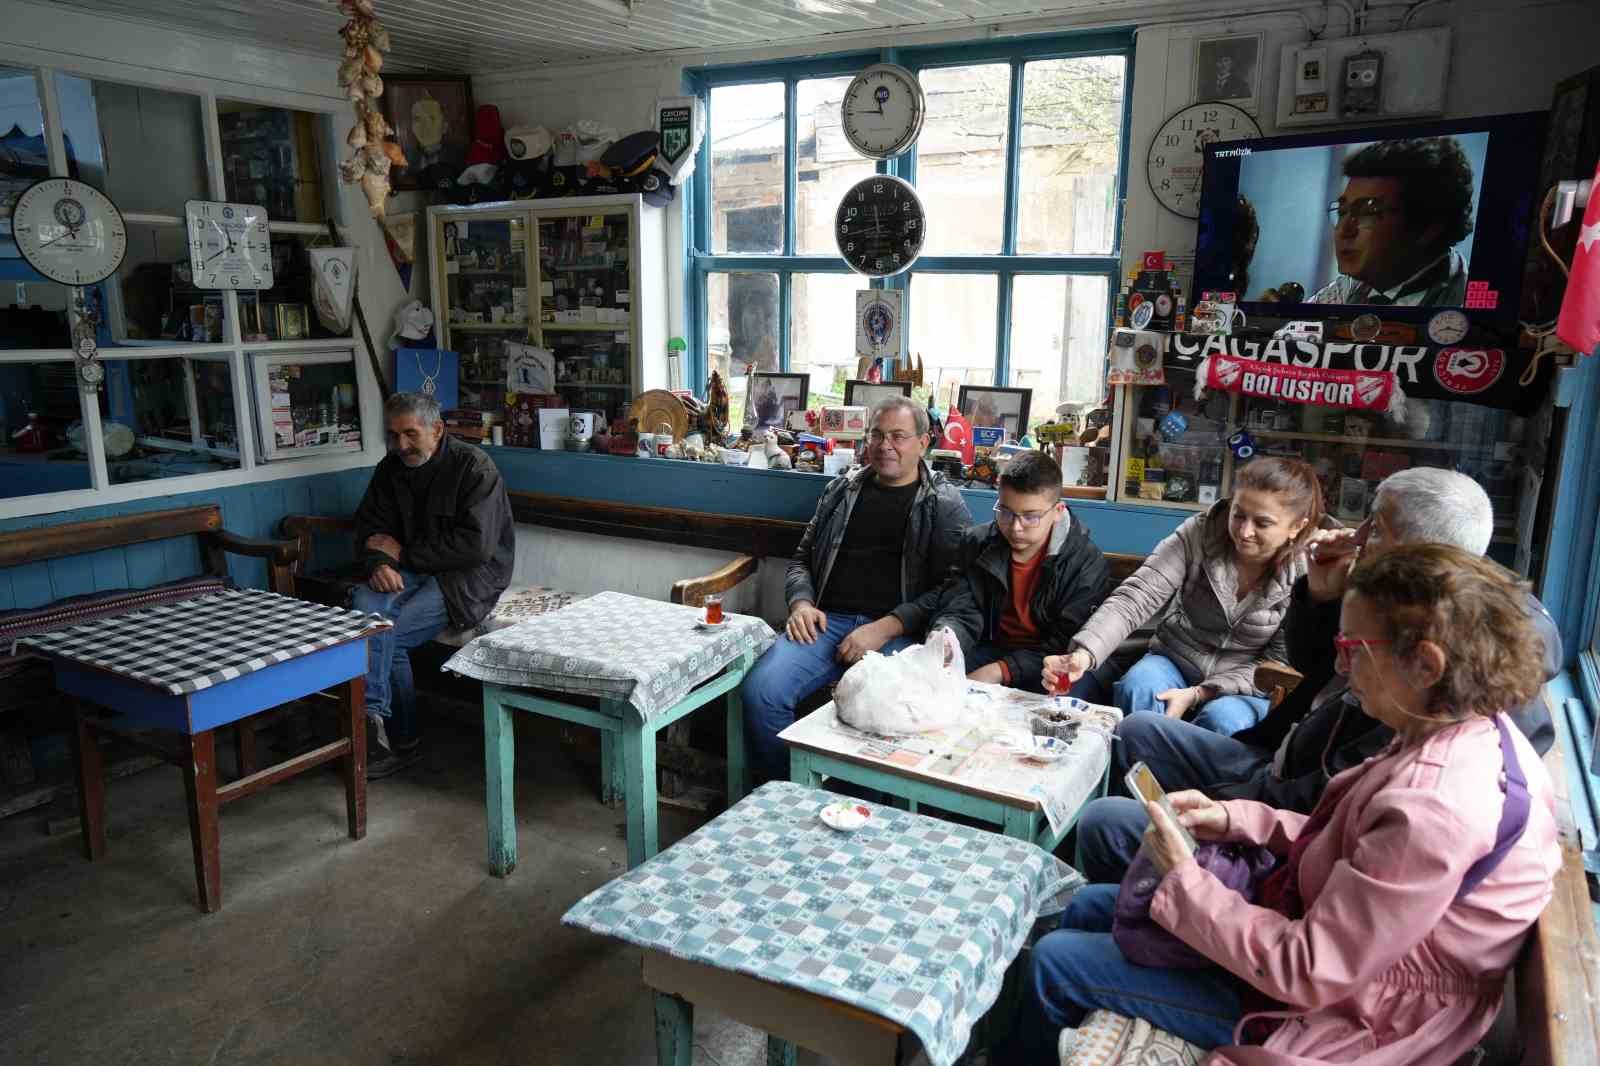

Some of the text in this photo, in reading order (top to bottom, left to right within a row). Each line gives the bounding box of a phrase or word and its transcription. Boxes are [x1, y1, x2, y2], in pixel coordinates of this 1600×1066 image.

[1202, 111, 1218, 122] 12
[1182, 120, 1193, 130] 11
[1230, 119, 1238, 129] 1
[1166, 135, 1179, 146] 10
[1156, 157, 1165, 167] 9
[873, 184, 884, 193] 12
[1161, 179, 1170, 190] 8
[858, 192, 864, 201] 11
[1175, 193, 1184, 205] 7
[903, 202, 912, 211] 2
[847, 207, 857, 217] 10
[841, 224, 849, 234] 9
[908, 219, 916, 229] 3
[859, 255, 866, 265] 7
[208, 273, 216, 283] 7
[230, 275, 239, 285] 6
[1242, 372, 1354, 405] BOLUSPOR
